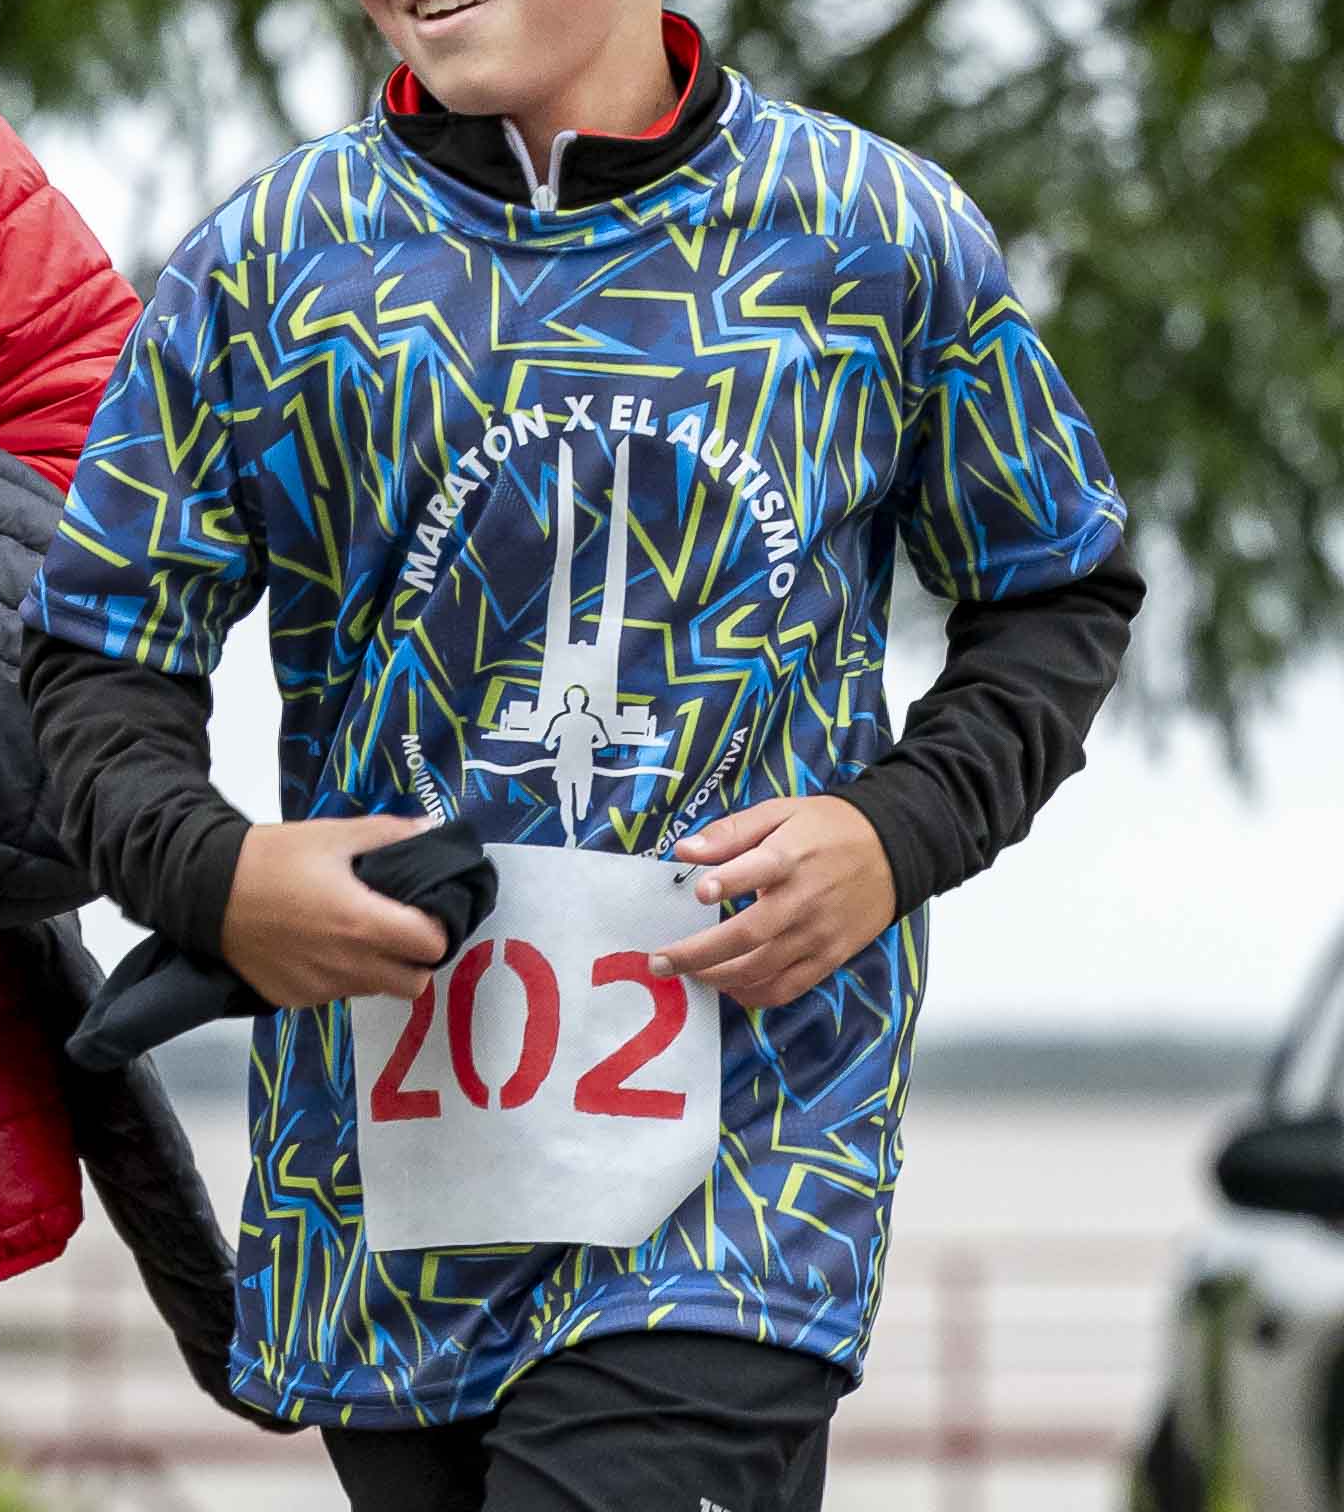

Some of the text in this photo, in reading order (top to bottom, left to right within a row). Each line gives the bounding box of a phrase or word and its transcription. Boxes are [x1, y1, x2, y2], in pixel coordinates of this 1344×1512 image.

[404, 395, 801, 600] MARATÓN X EL AUTISMO
[685, 727, 749, 819] POSITIVA
[370, 938, 689, 1123] 202
